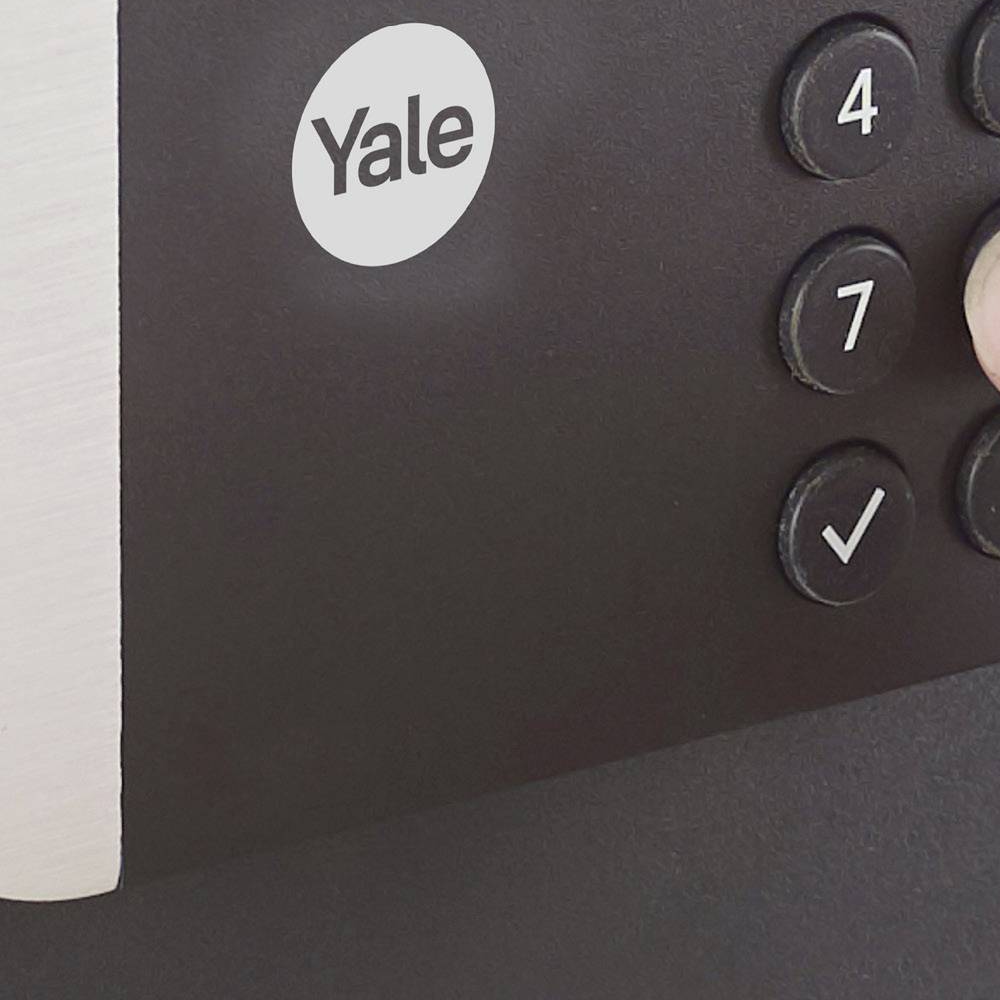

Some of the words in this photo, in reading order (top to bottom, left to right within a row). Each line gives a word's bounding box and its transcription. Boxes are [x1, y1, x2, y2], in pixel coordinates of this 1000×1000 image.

[837, 67, 879, 135] 4
[311, 94, 474, 196] Yale
[836, 279, 874, 352] 7
